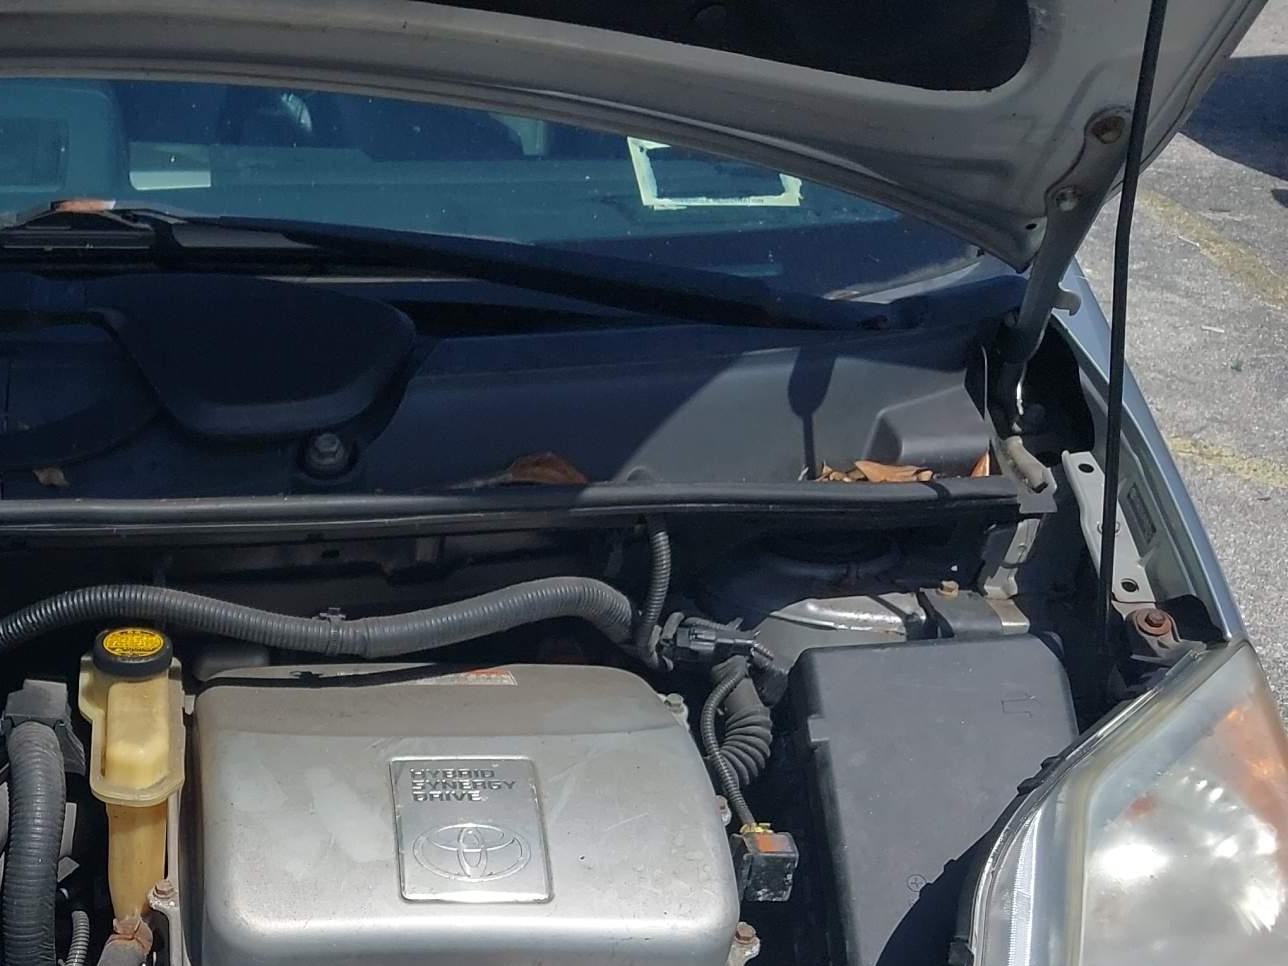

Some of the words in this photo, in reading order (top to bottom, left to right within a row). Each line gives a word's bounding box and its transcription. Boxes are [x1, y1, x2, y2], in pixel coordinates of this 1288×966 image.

[410, 768, 495, 779] HYBRID
[412, 780, 516, 790] SYNERGY
[413, 791, 482, 801] DRIVE
